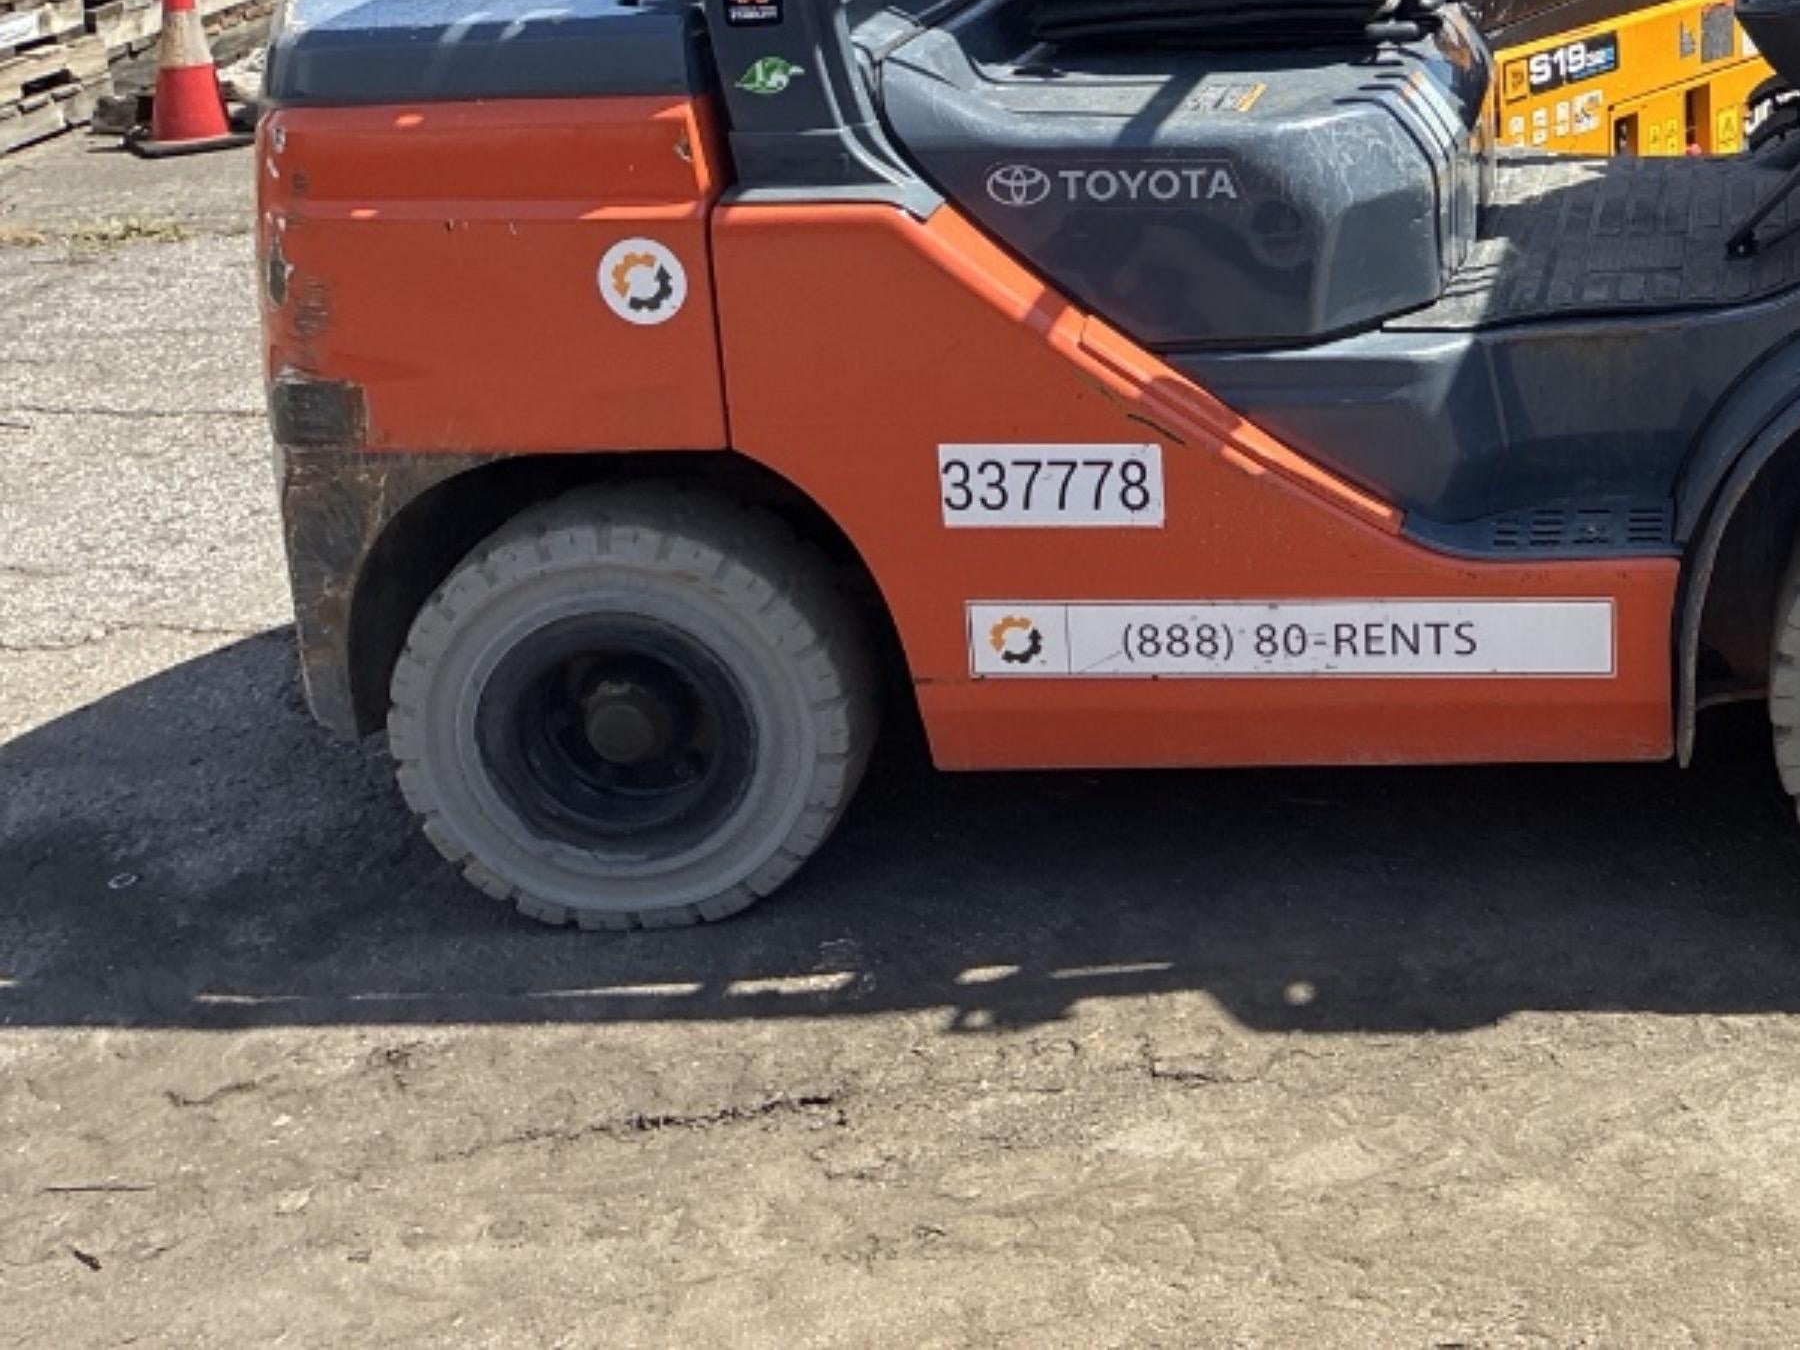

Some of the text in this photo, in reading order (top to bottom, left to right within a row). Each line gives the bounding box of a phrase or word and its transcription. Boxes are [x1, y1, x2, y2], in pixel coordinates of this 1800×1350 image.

[1058, 169, 1238, 201] TOYOTA
[942, 460, 1150, 511] 337778
[1122, 622, 1478, 662] (888) 80-RENTS
